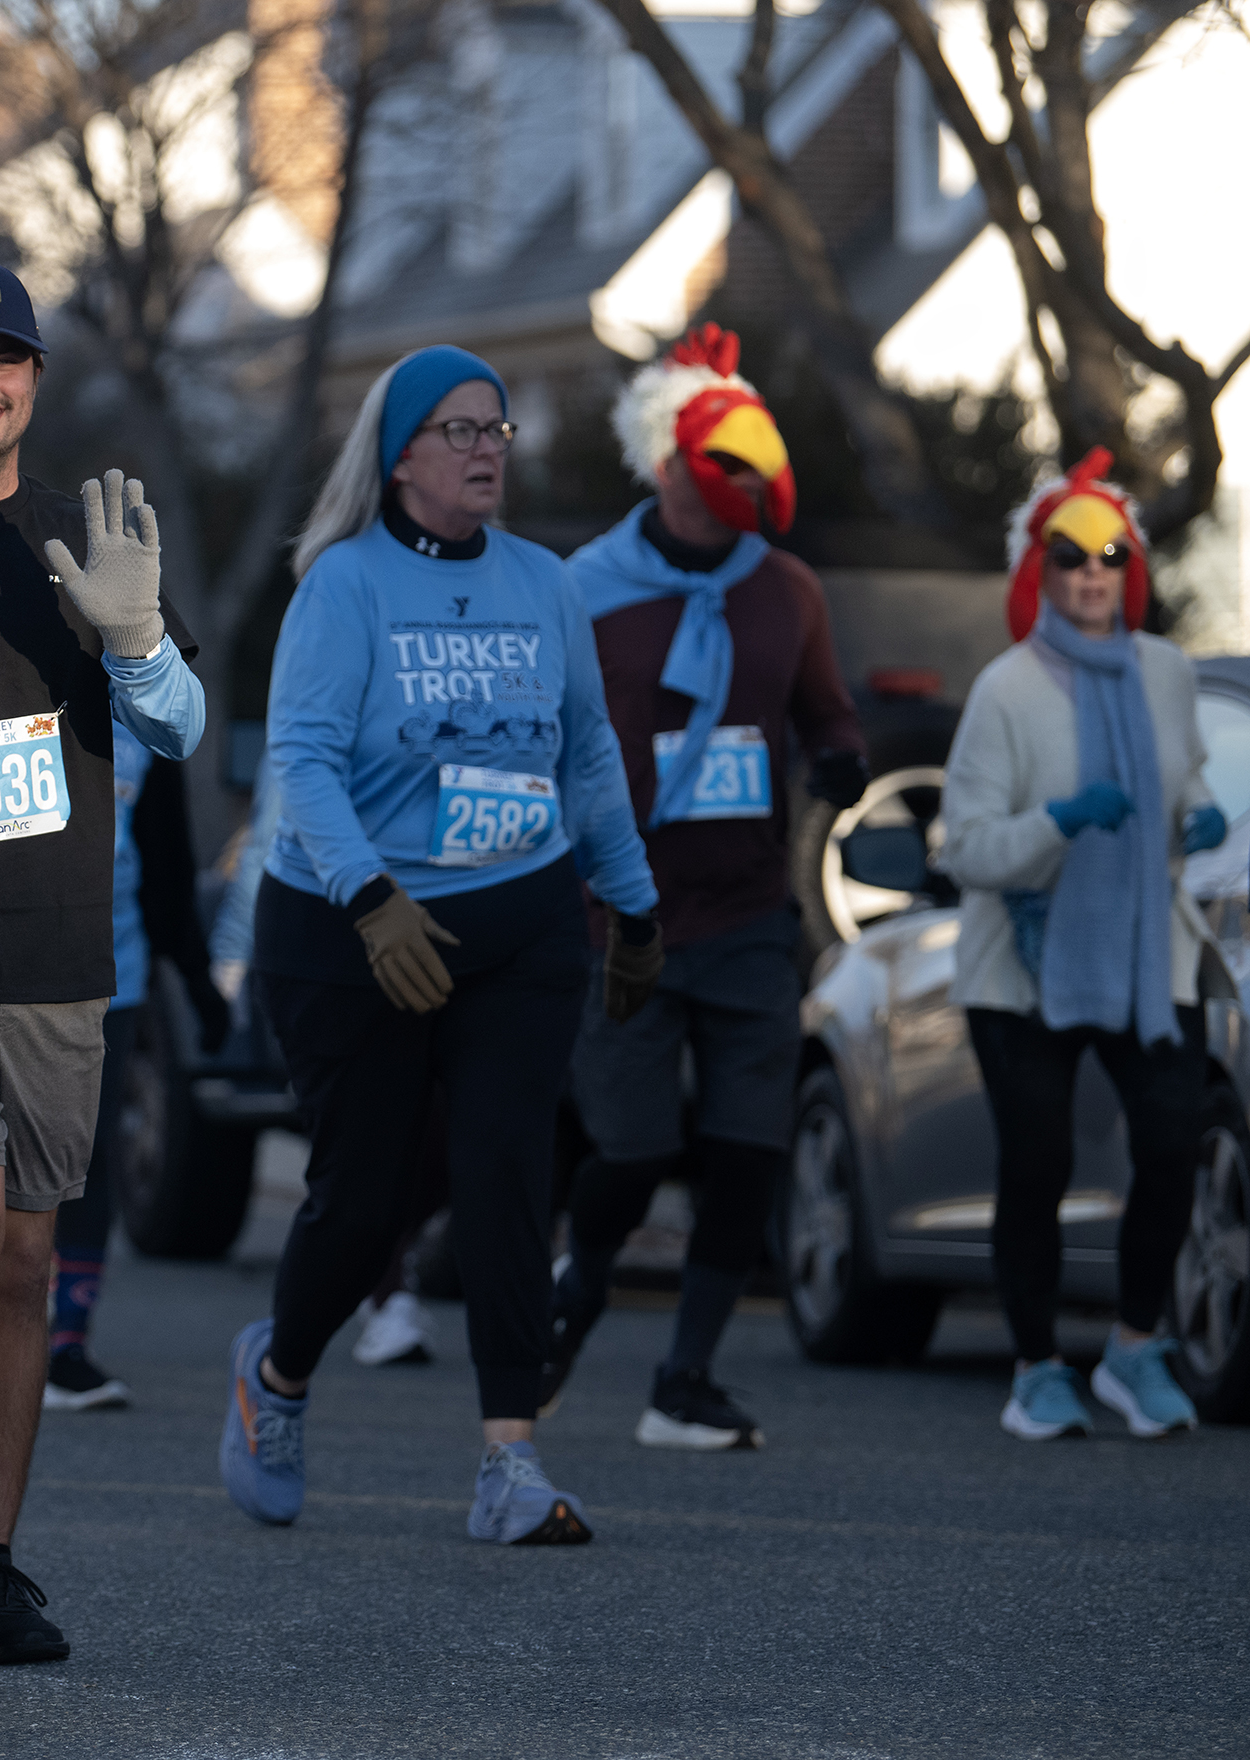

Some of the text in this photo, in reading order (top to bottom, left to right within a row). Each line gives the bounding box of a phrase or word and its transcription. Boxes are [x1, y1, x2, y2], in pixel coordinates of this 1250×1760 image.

[48, 575, 63, 583] PA
[390, 632, 541, 669] TURKEY
[395, 670, 496, 706] TROT
[4, 731, 17, 743] 5K
[693, 752, 762, 801] 231
[442, 794, 549, 851] 2582
